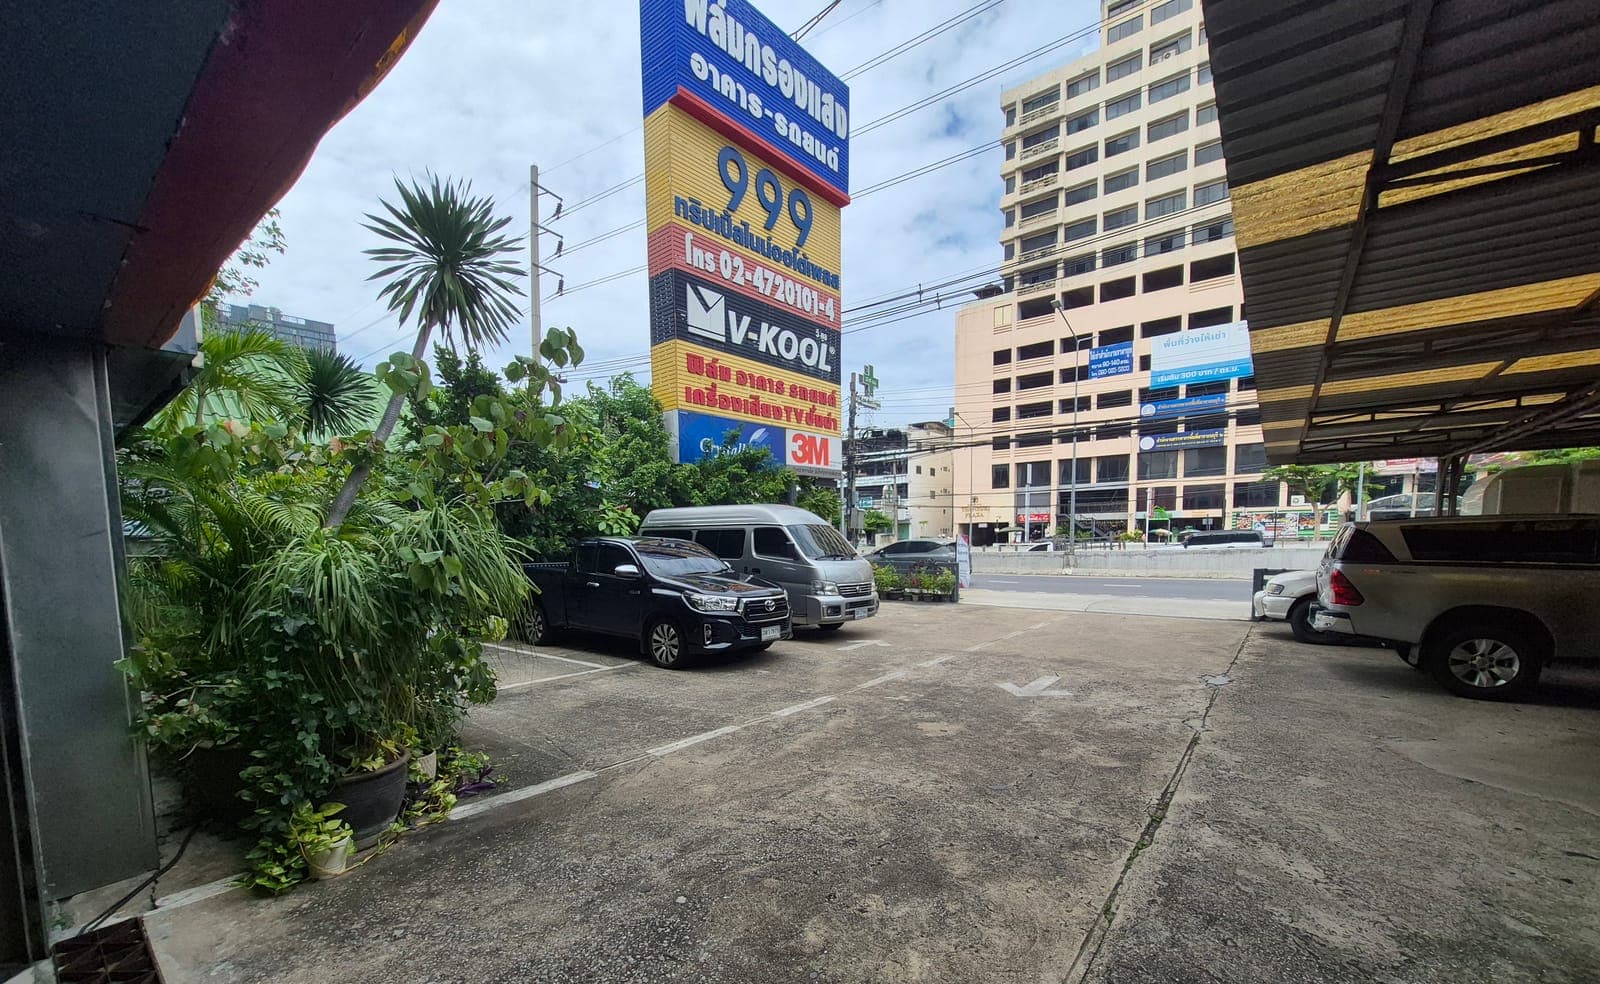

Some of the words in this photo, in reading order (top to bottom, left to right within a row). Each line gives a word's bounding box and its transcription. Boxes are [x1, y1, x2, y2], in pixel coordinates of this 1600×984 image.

[684, 0, 848, 140] ฟล์มกรองแสง
[690, 52, 839, 173] อาคาร-รถยนต์
[717, 145, 813, 248] 999
[685, 232, 716, 273] โทร
[719, 250, 835, 322] 02-4720101-4
[686, 352, 732, 382] ฟิล์ม
[735, 370, 785, 395] อาคาร
[789, 384, 837, 408] รถยนต์
[1181, 371, 1197, 379] 300
[791, 433, 830, 467] 3M
